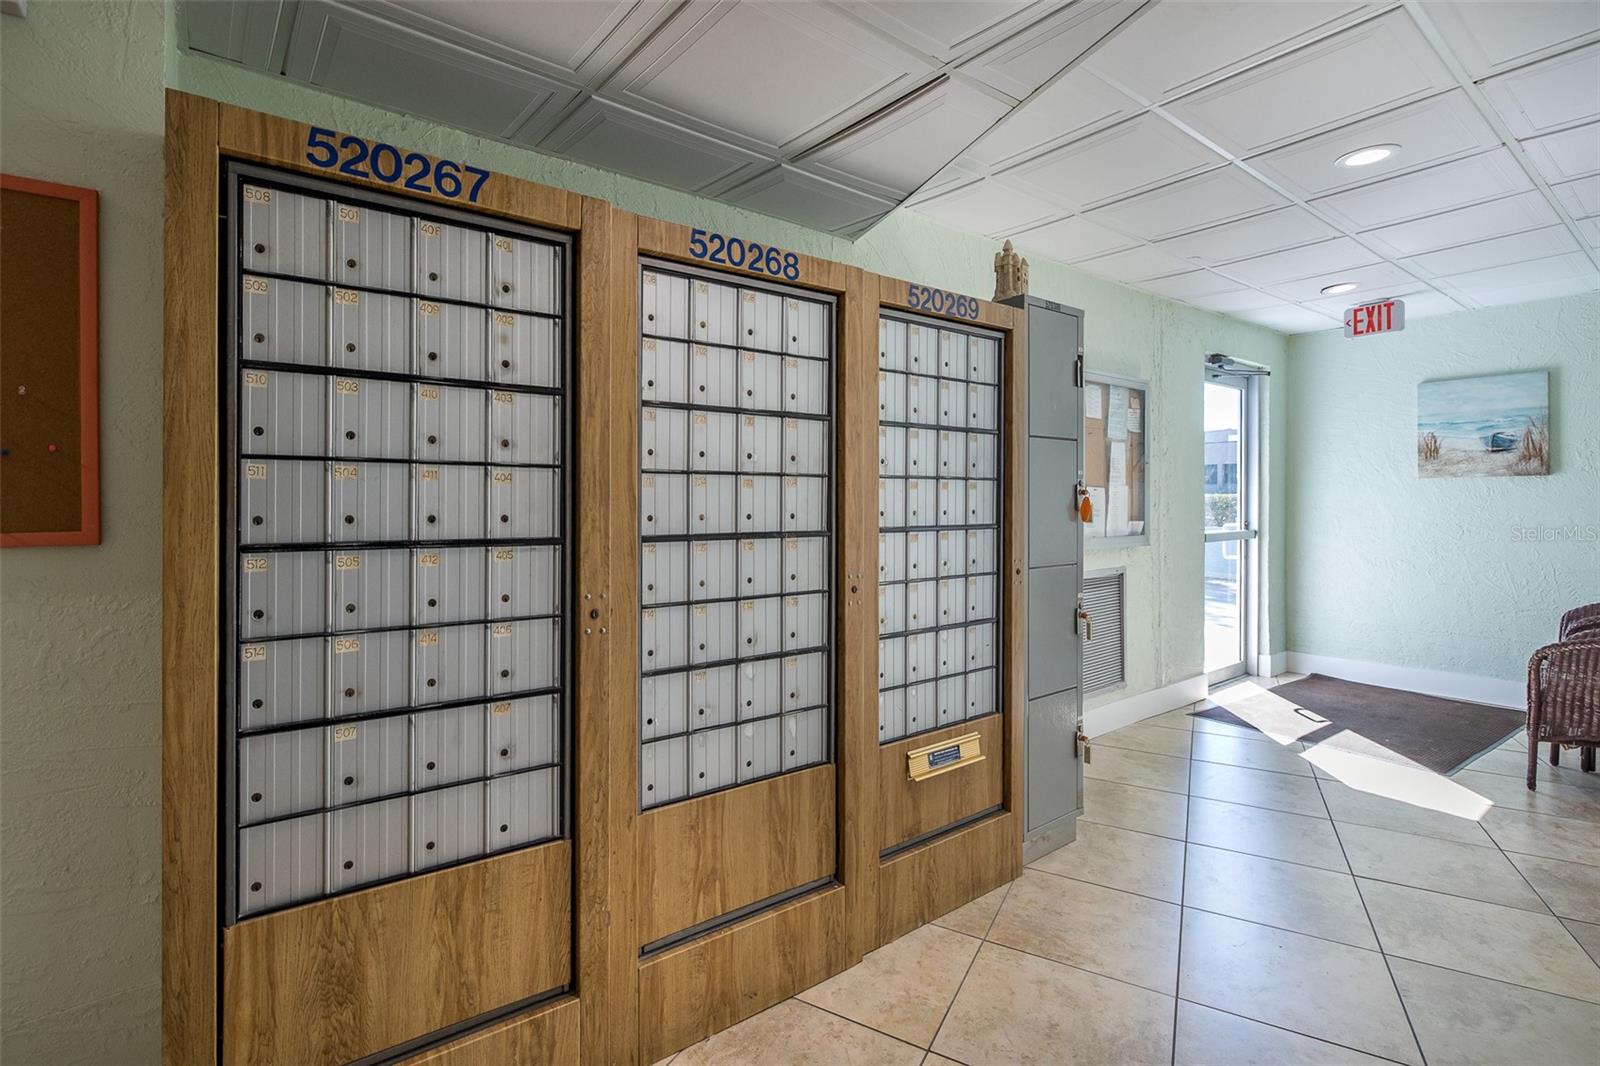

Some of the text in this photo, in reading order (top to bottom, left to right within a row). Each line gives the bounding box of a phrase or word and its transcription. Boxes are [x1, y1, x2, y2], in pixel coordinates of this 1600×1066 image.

[306, 126, 490, 203] 520267
[246, 188, 271, 202] 508
[340, 208, 359, 220] 501
[688, 228, 800, 281] 520268
[245, 279, 268, 291] 509
[336, 290, 358, 303] 502
[907, 284, 979, 320] 520269
[1353, 301, 1394, 336] EXIT
[246, 373, 267, 385] 510
[337, 381, 359, 392] 503
[421, 389, 438, 399] 410
[495, 393, 513, 403] 403
[247, 465, 265, 476] 511
[335, 467, 357, 477] 504
[422, 469, 439, 479] 411
[494, 472, 512, 482] 404
[421, 554, 439, 565] 412
[496, 550, 514, 560] 405
[246, 558, 268, 570] 512
[337, 556, 360, 568] 505
[420, 633, 438, 643] 414
[336, 639, 359, 650] 506
[244, 647, 265, 659] 514
[336, 727, 357, 739] 507
